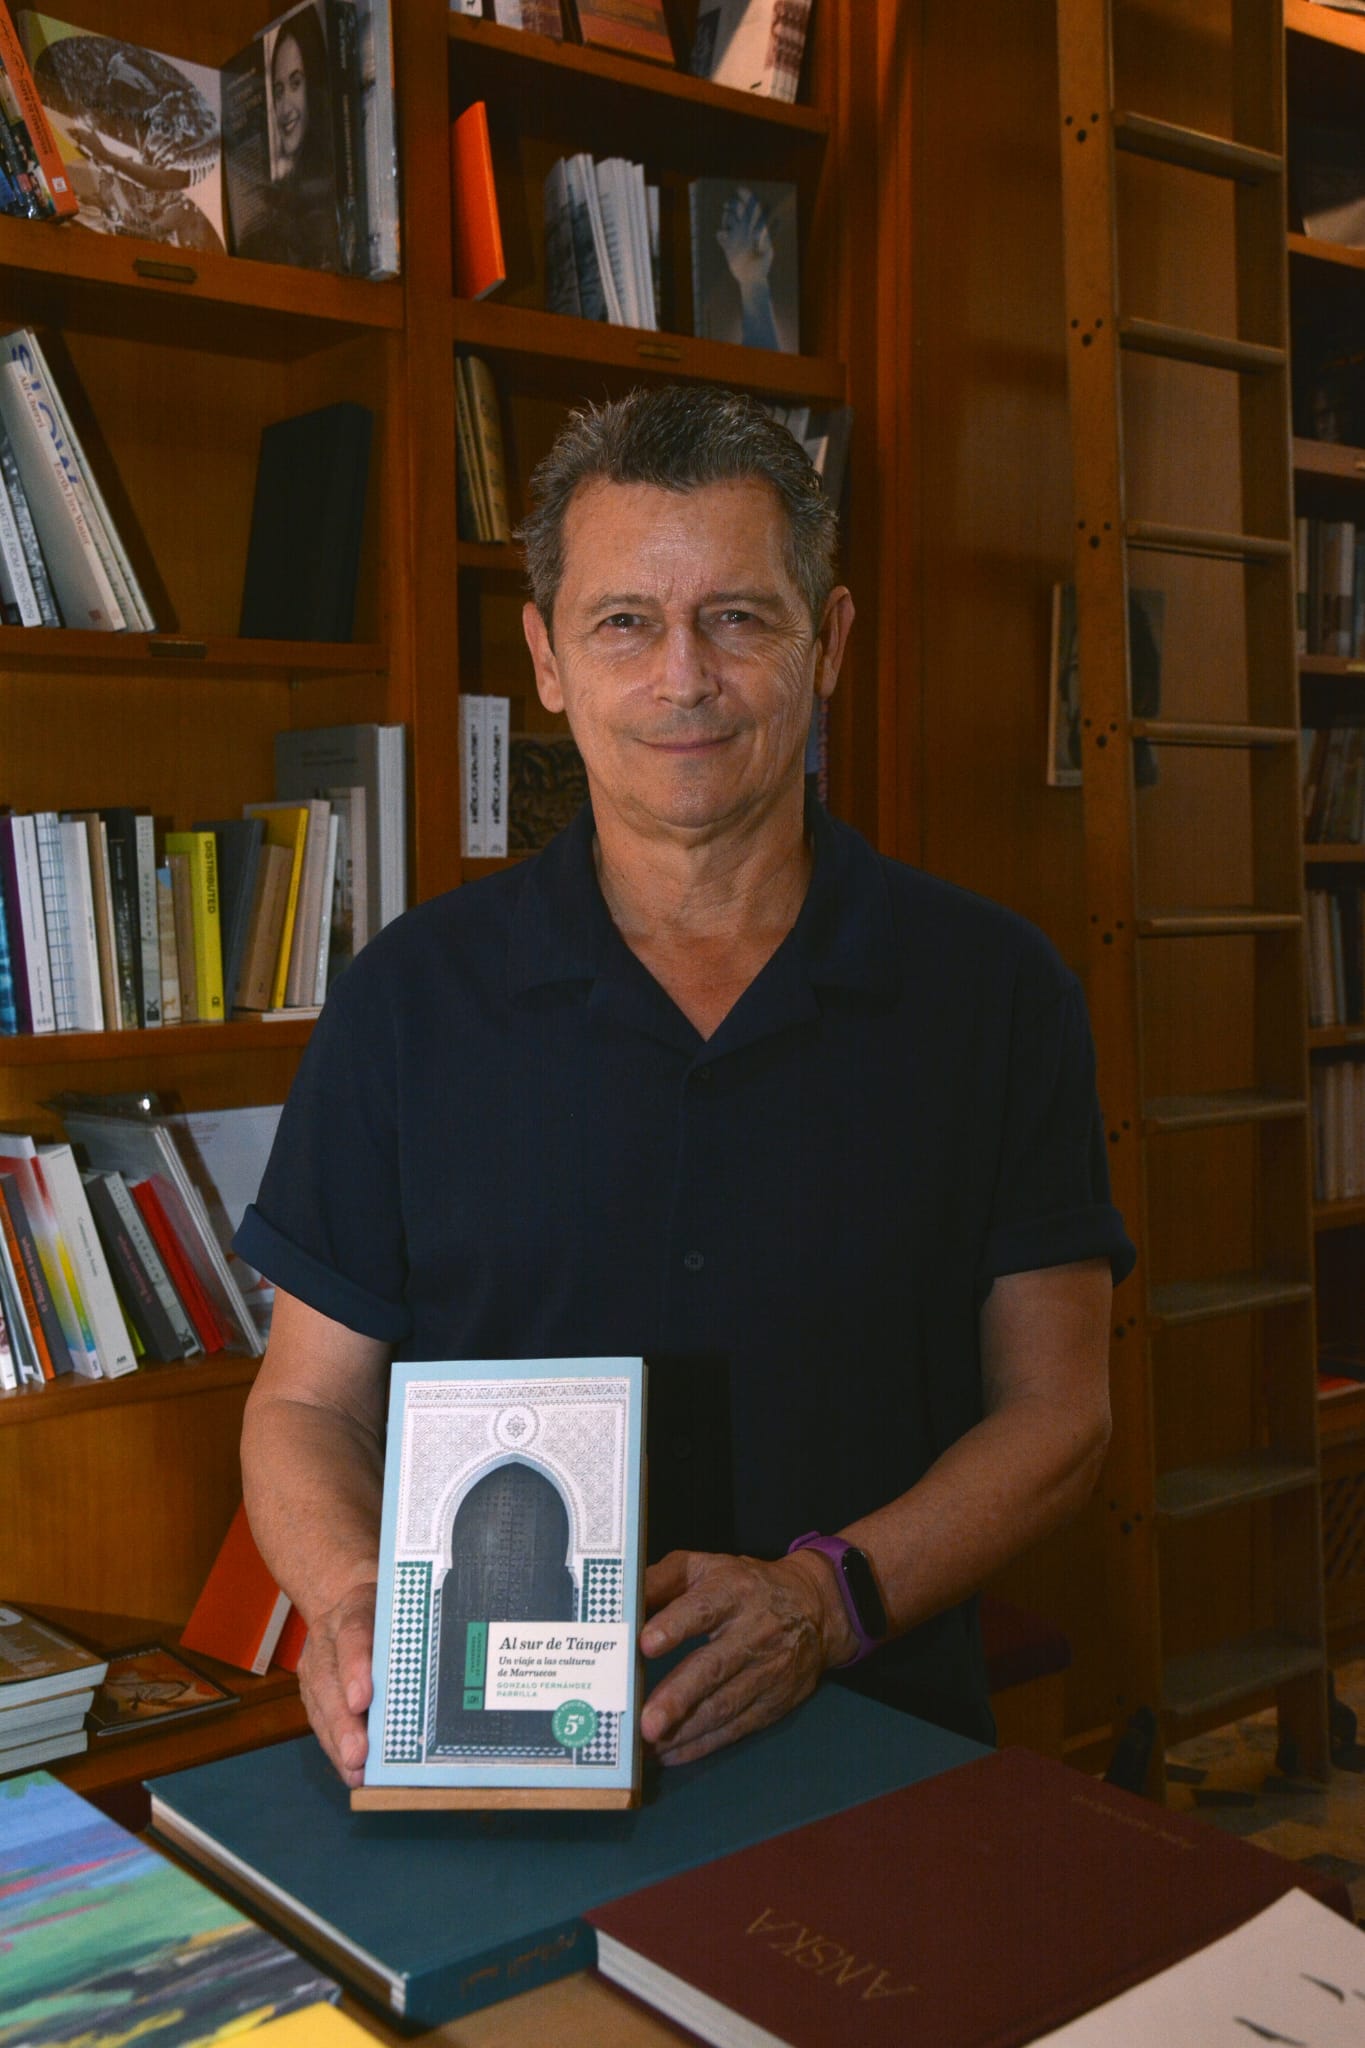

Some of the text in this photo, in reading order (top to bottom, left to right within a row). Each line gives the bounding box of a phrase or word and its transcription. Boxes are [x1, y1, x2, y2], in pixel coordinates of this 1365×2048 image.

[54, 461, 71, 496] Earth
[204, 839, 217, 915] DISTRIBUTED
[499, 1637, 617, 1653] Al sur de Tánger
[498, 1656, 512, 1665] Un
[513, 1656, 535, 1667] viaje
[544, 1656, 557, 1665] las
[558, 1656, 596, 1666] culturas
[497, 1668, 557, 1677] de Marruecos
[540, 1680, 592, 1690] FERNÁNDEZ
